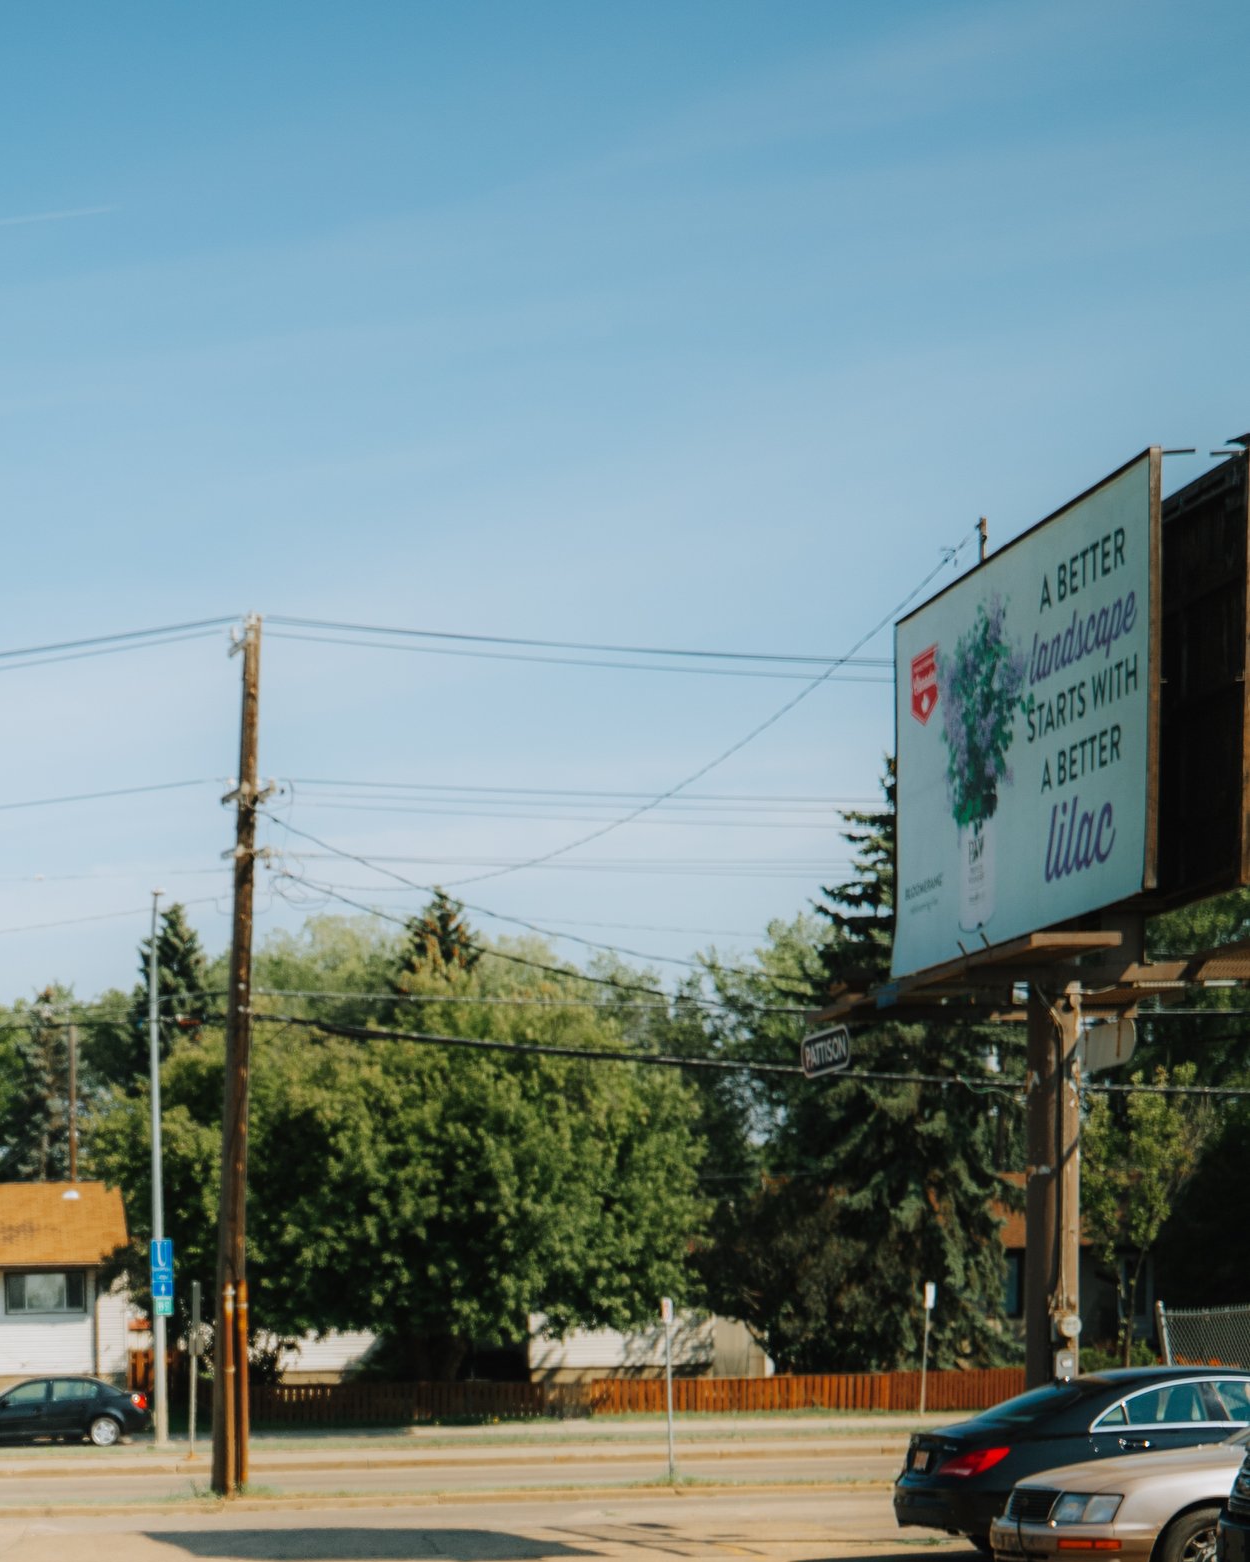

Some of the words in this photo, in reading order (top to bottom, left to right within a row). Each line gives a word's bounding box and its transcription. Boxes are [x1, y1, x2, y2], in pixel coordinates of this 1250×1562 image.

[1039, 573, 1052, 613] A
[1057, 527, 1126, 601] BETTER
[1029, 590, 1138, 687] landscape
[1026, 682, 1087, 743] STARTS
[1092, 654, 1138, 707] WITH
[1041, 758, 1053, 795] A
[1057, 724, 1122, 788] BETTER
[1044, 795, 1117, 883] lilac
[805, 1034, 847, 1069] PATTISON
